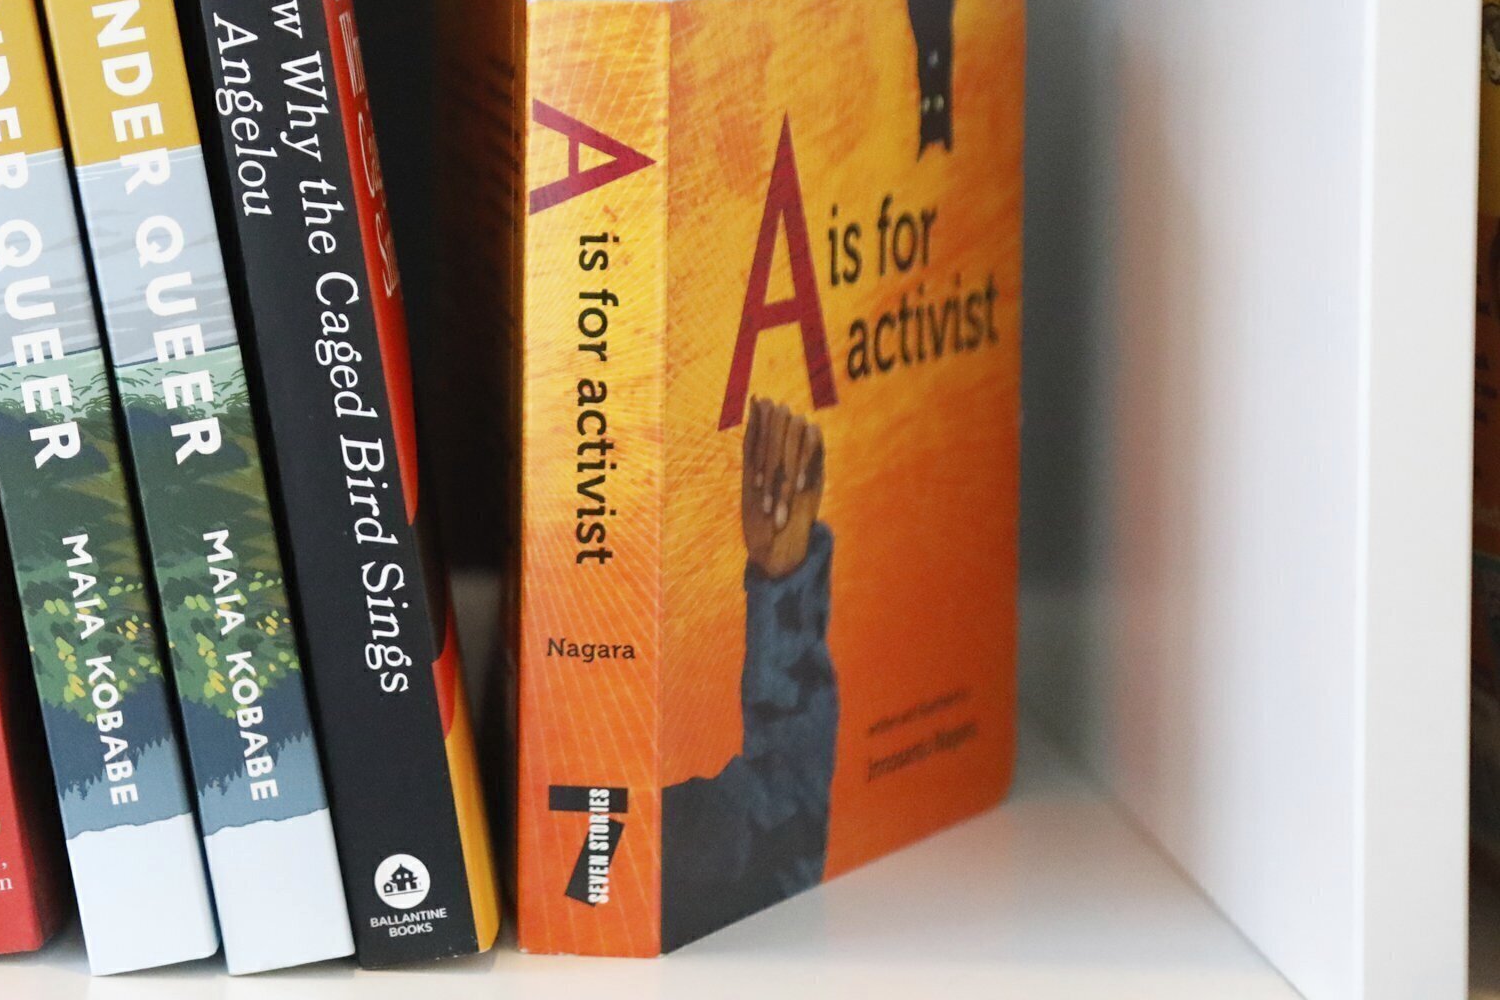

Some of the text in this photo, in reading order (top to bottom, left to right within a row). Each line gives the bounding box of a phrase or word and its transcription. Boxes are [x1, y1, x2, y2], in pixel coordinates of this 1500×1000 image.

[212, 12, 279, 218] Angelou
[279, 50, 331, 163] Why
[299, 177, 345, 255] the
[717, 109, 938, 433] A is for
[136, 215, 222, 466] QUEER
[314, 270, 379, 419] Caged
[528, 97, 658, 566] A is for activist
[846, 274, 999, 382] activist
[338, 433, 399, 546] Bird
[62, 532, 139, 806] MAIA KOBABE
[203, 528, 280, 802] MAIA KOBABE
[360, 560, 413, 694] Sings
[546, 636, 636, 663] Nagara
[587, 787, 610, 904] SEVEN STORIES
[369, 907, 448, 928] BALLANTINE
[388, 922, 434, 938] BOOKS
